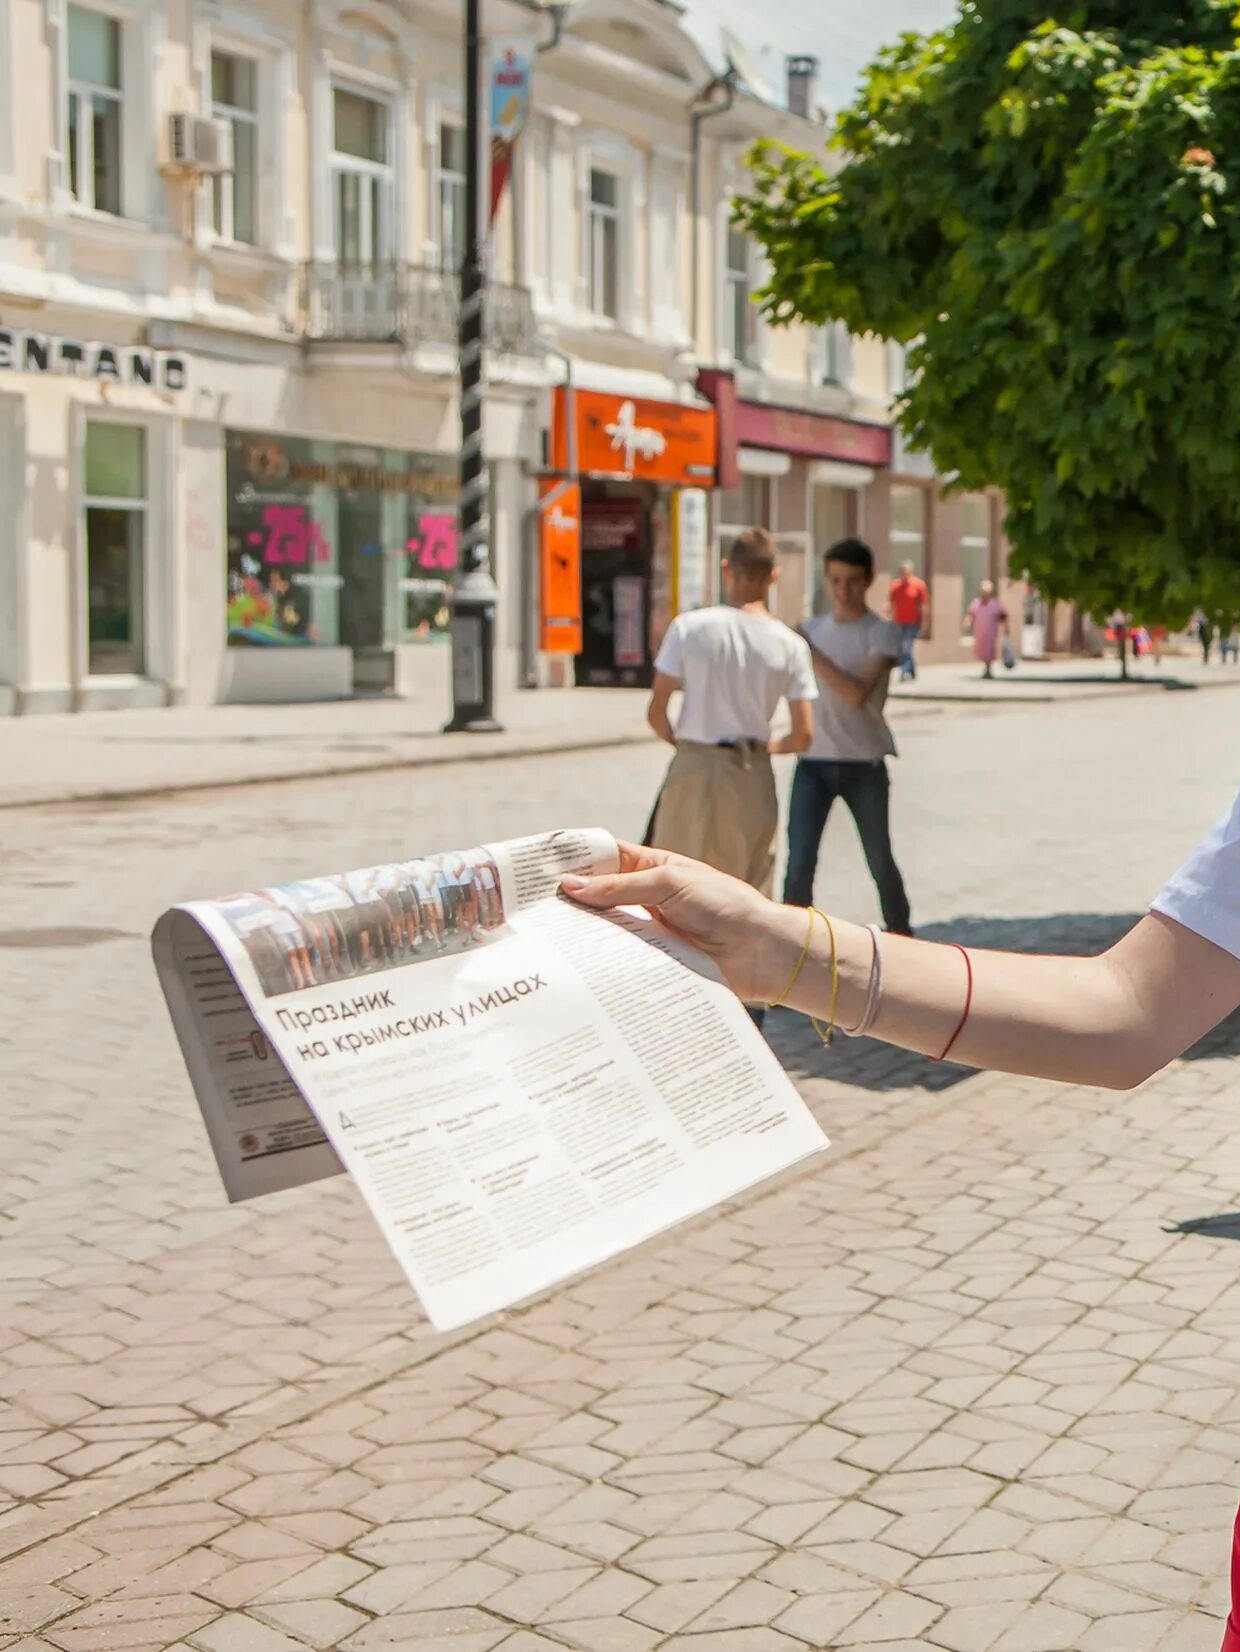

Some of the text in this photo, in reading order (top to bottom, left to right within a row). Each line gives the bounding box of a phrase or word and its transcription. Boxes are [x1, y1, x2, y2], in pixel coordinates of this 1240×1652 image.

[274, 988, 397, 1034] Праздник
[297, 1040, 331, 1062] на
[332, 1009, 450, 1056] крымских
[450, 972, 549, 1027] улицах
